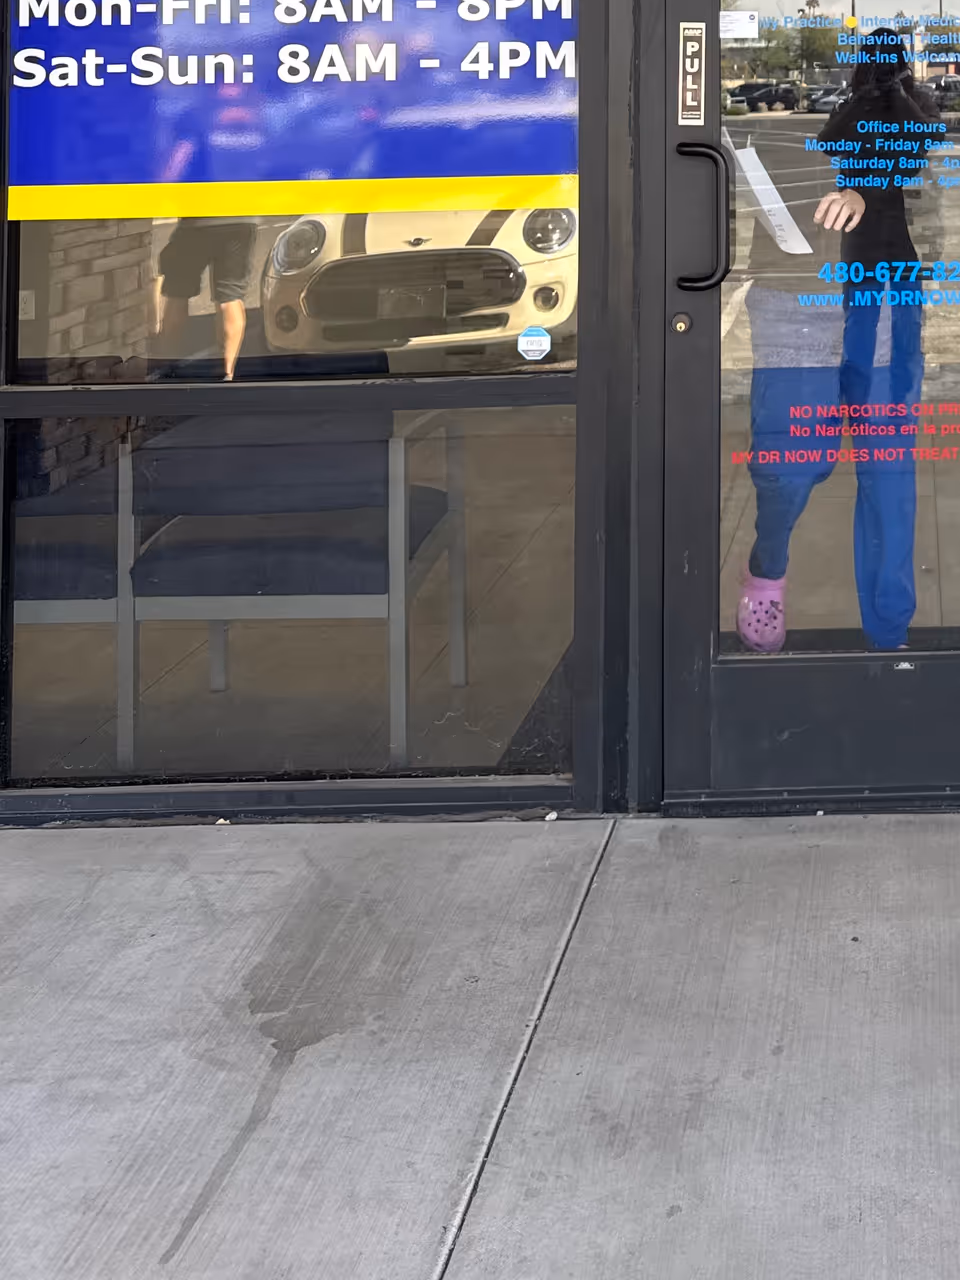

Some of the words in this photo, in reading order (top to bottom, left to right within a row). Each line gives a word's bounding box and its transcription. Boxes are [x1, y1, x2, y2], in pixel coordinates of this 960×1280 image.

[415, 0, 437, 10] -
[783, 15, 842, 28] Practice
[860, 14, 914, 27] Internal
[837, 32, 914, 46] Behavioral
[11, 45, 255, 88] Sat-Sun:
[277, 42, 397, 84] 8AM
[419, 58, 441, 68] -
[460, 40, 576, 80] 4PM
[835, 50, 898, 64] Walk-Ins
[685, 41, 700, 106] PULL
[857, 120, 900, 133] Office
[903, 120, 947, 133] Hours
[804, 138, 862, 153] Monday
[875, 138, 920, 153] Friday
[923, 138, 954, 151] 8am
[830, 157, 895, 172] Saturday
[898, 156, 929, 169] 8am
[835, 175, 890, 189] Sunday
[893, 174, 924, 187] 8am
[789, 405, 813, 418] NO
[816, 403, 907, 418] NARCOTICS
[911, 403, 934, 417] ON
[789, 424, 811, 437] No
[815, 422, 896, 437] Narcóticos
[900, 425, 918, 435] en
[923, 422, 937, 435] la
[731, 451, 754, 465] MY
[758, 451, 780, 464] DR
[784, 450, 822, 464] NOW
[826, 449, 870, 463] DOES
[873, 448, 906, 462] NOT
[909, 447, 959, 461] TREAT
